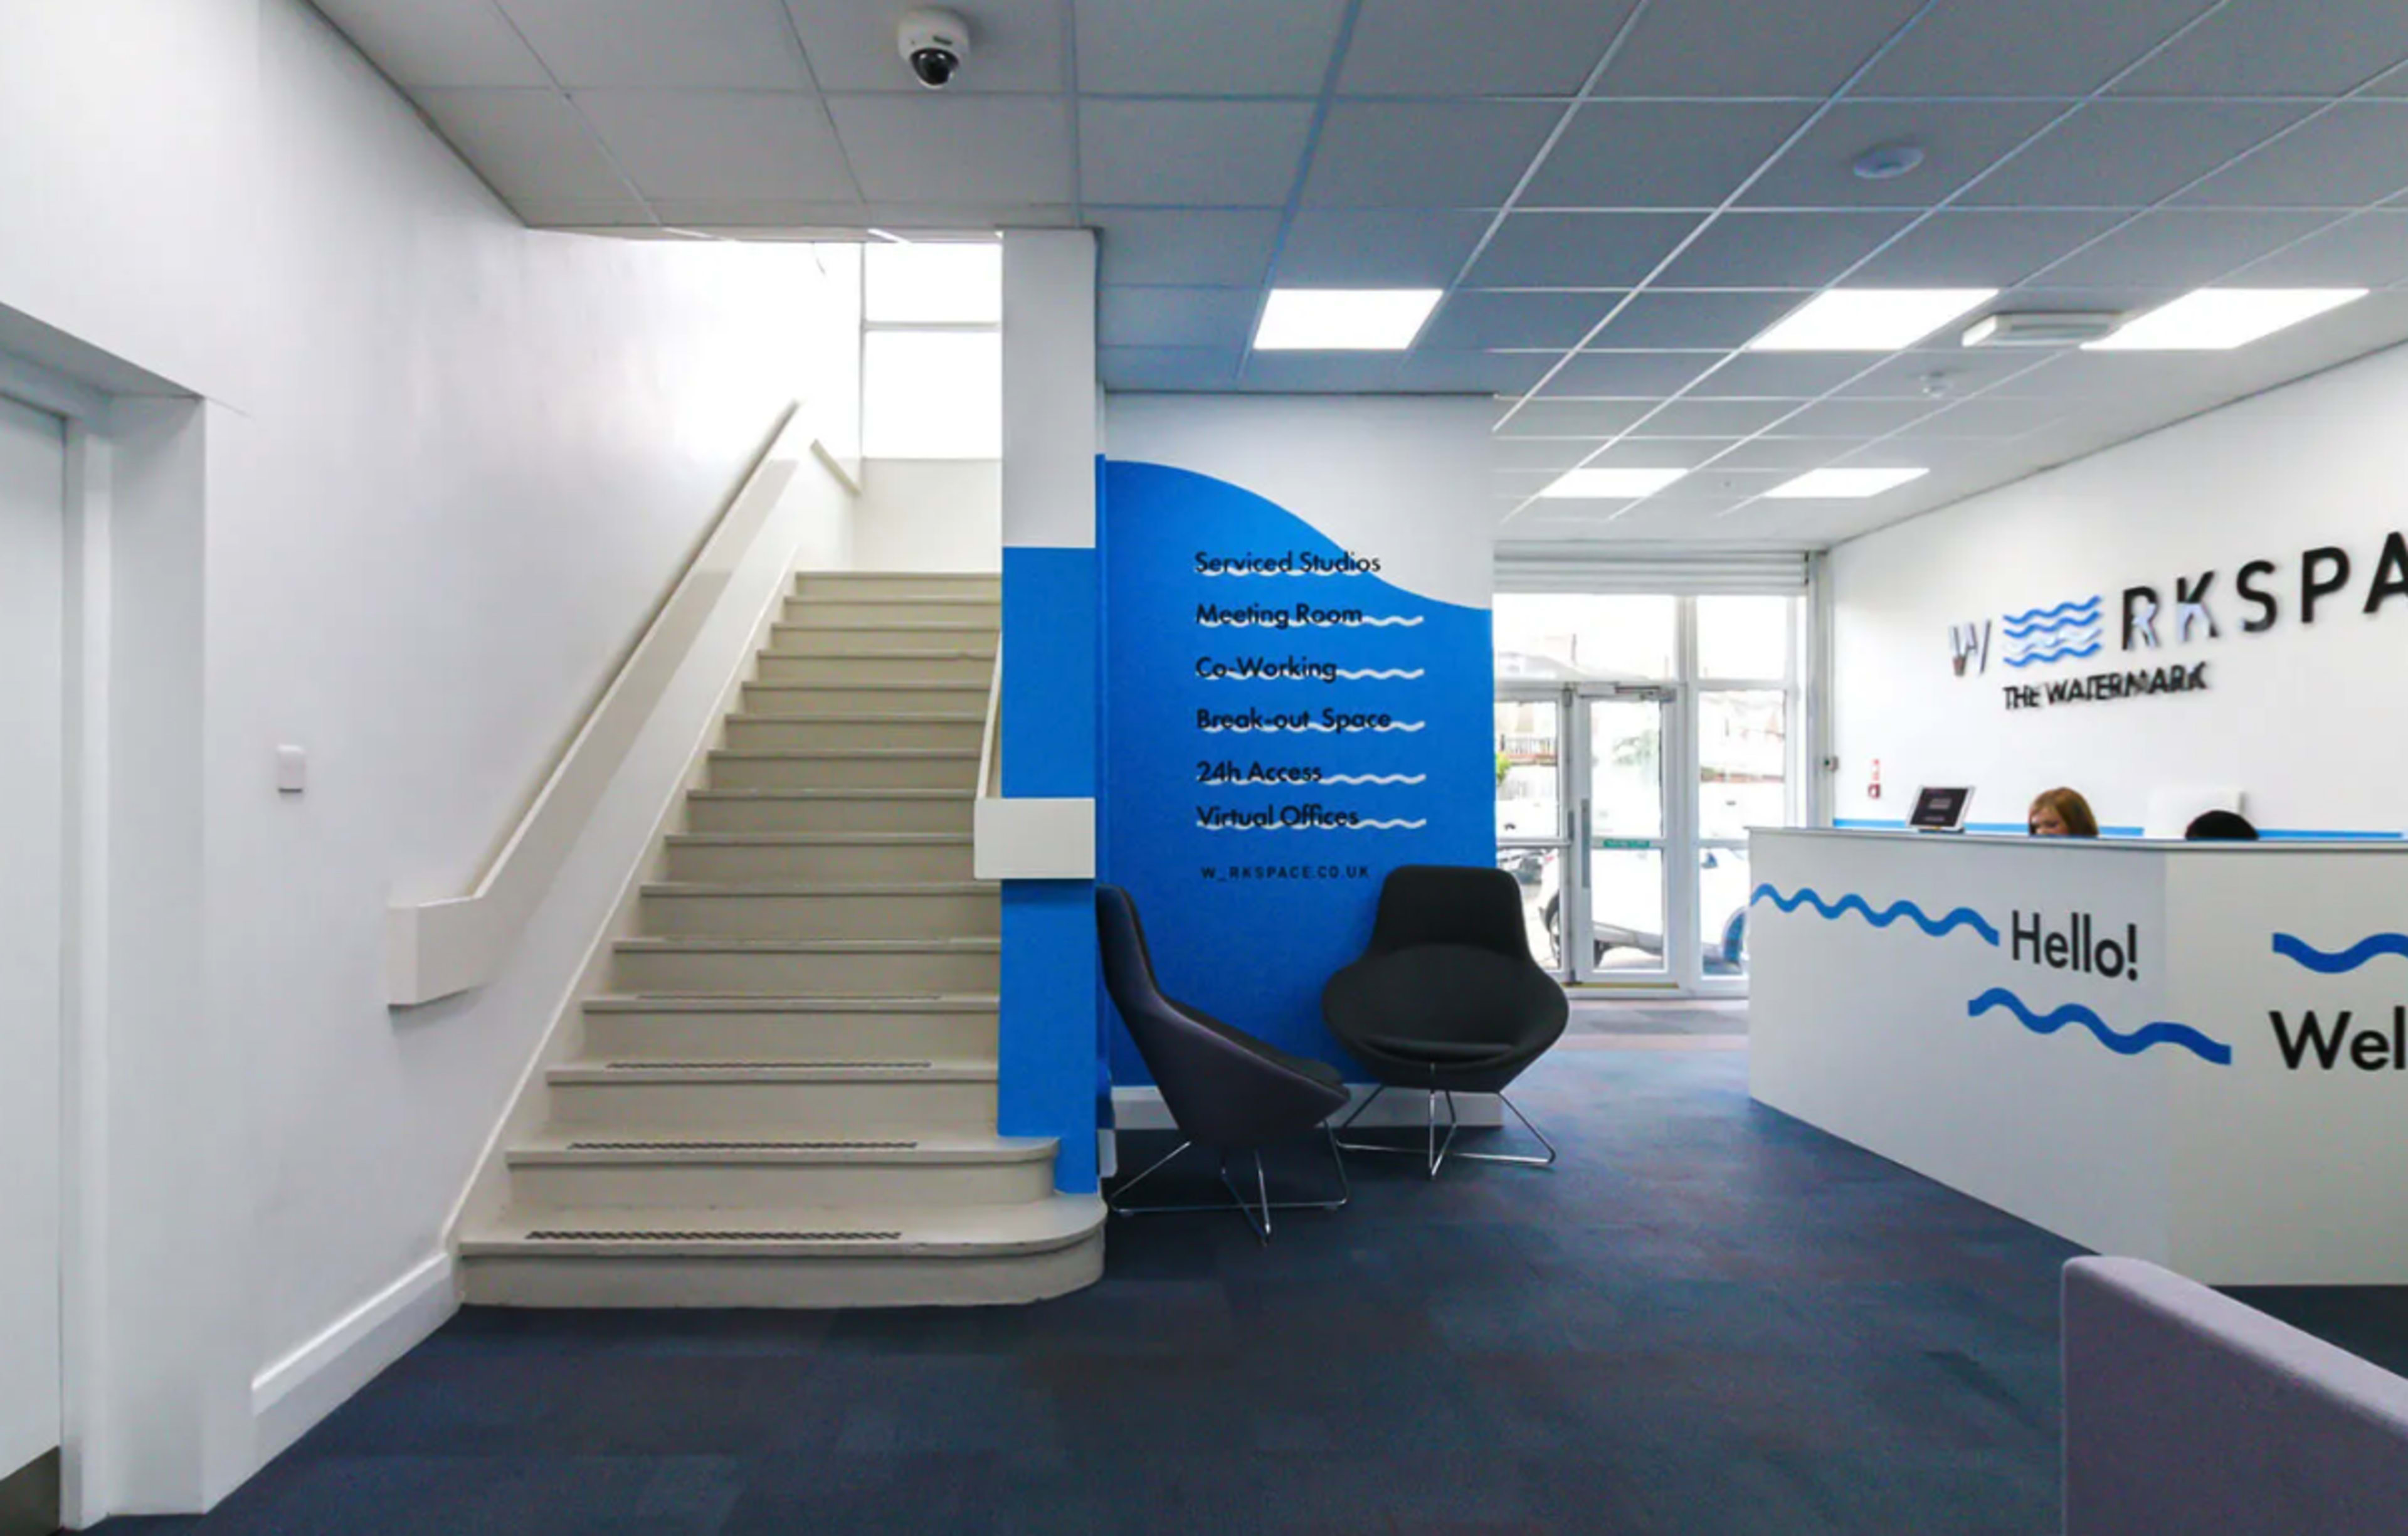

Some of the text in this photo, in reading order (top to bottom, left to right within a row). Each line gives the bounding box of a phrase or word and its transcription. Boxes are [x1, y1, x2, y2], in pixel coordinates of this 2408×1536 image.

[1195, 551, 1381, 573] Serviced Studios
[1195, 603, 1363, 630] Meeting Room
[1195, 655, 1337, 683] Co-Working
[2003, 660, 2207, 709] THE WATERMARK
[1196, 707, 1392, 733] Break-out Space
[1196, 760, 1323, 782] 24h Access
[1196, 804, 1360, 827] Virtual Offices
[2012, 909, 2138, 982] Hello!
[2268, 1005, 2407, 1071] Wel
